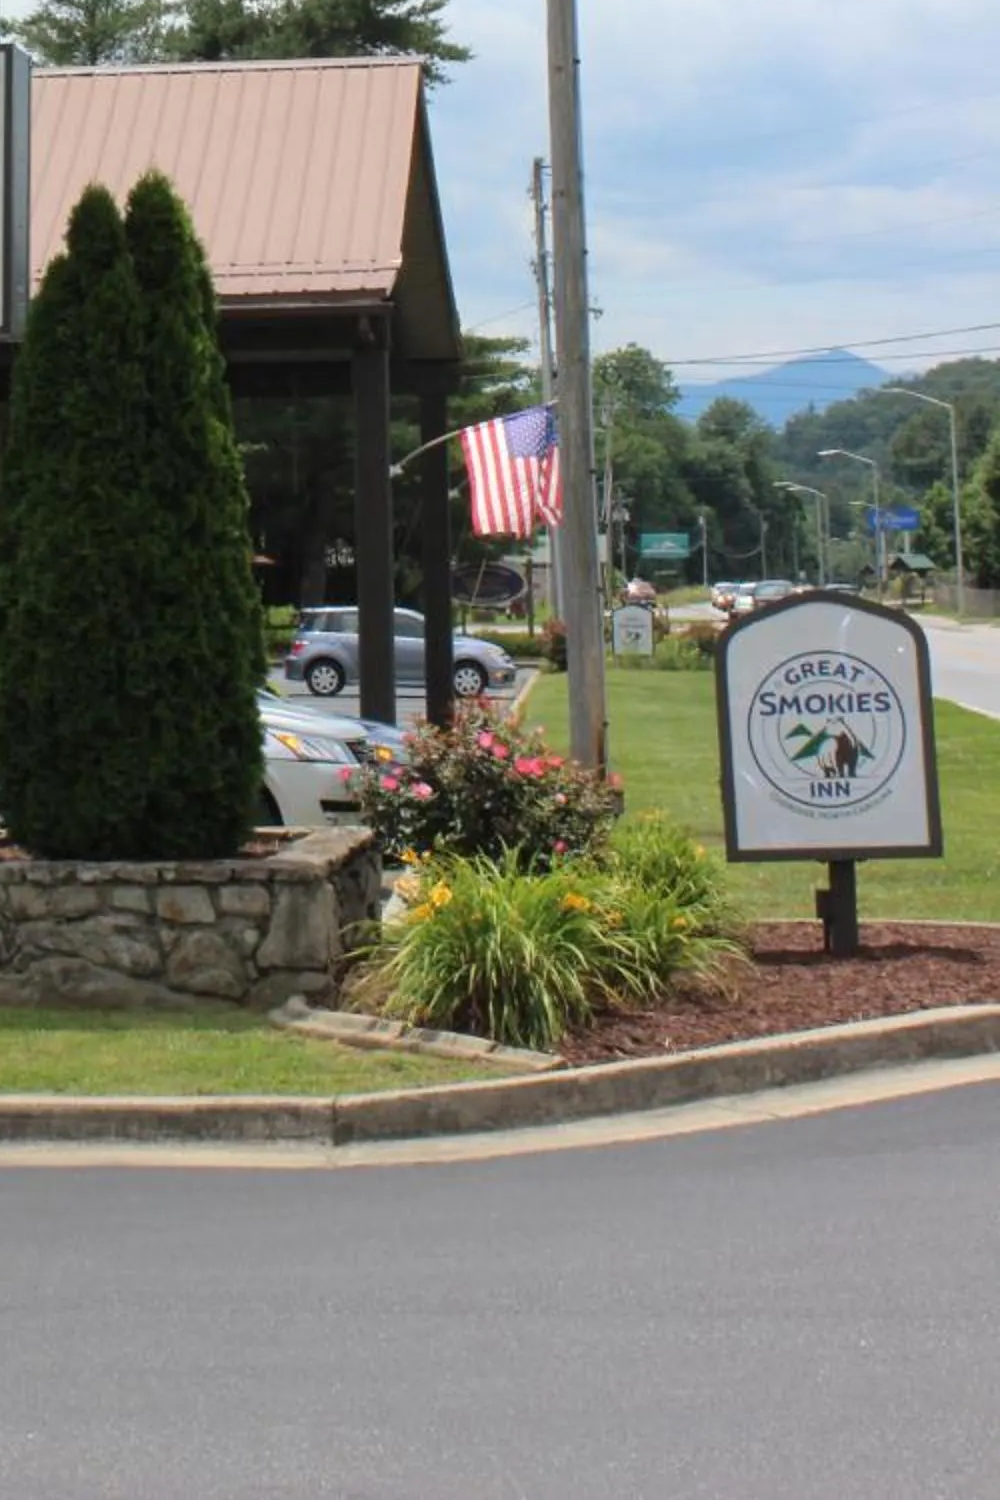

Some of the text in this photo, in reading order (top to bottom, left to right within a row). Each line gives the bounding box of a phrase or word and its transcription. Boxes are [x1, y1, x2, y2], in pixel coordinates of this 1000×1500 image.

[784, 660, 865, 686] GREAT
[759, 691, 892, 717] SMOKIES
[809, 782, 851, 798] INN
